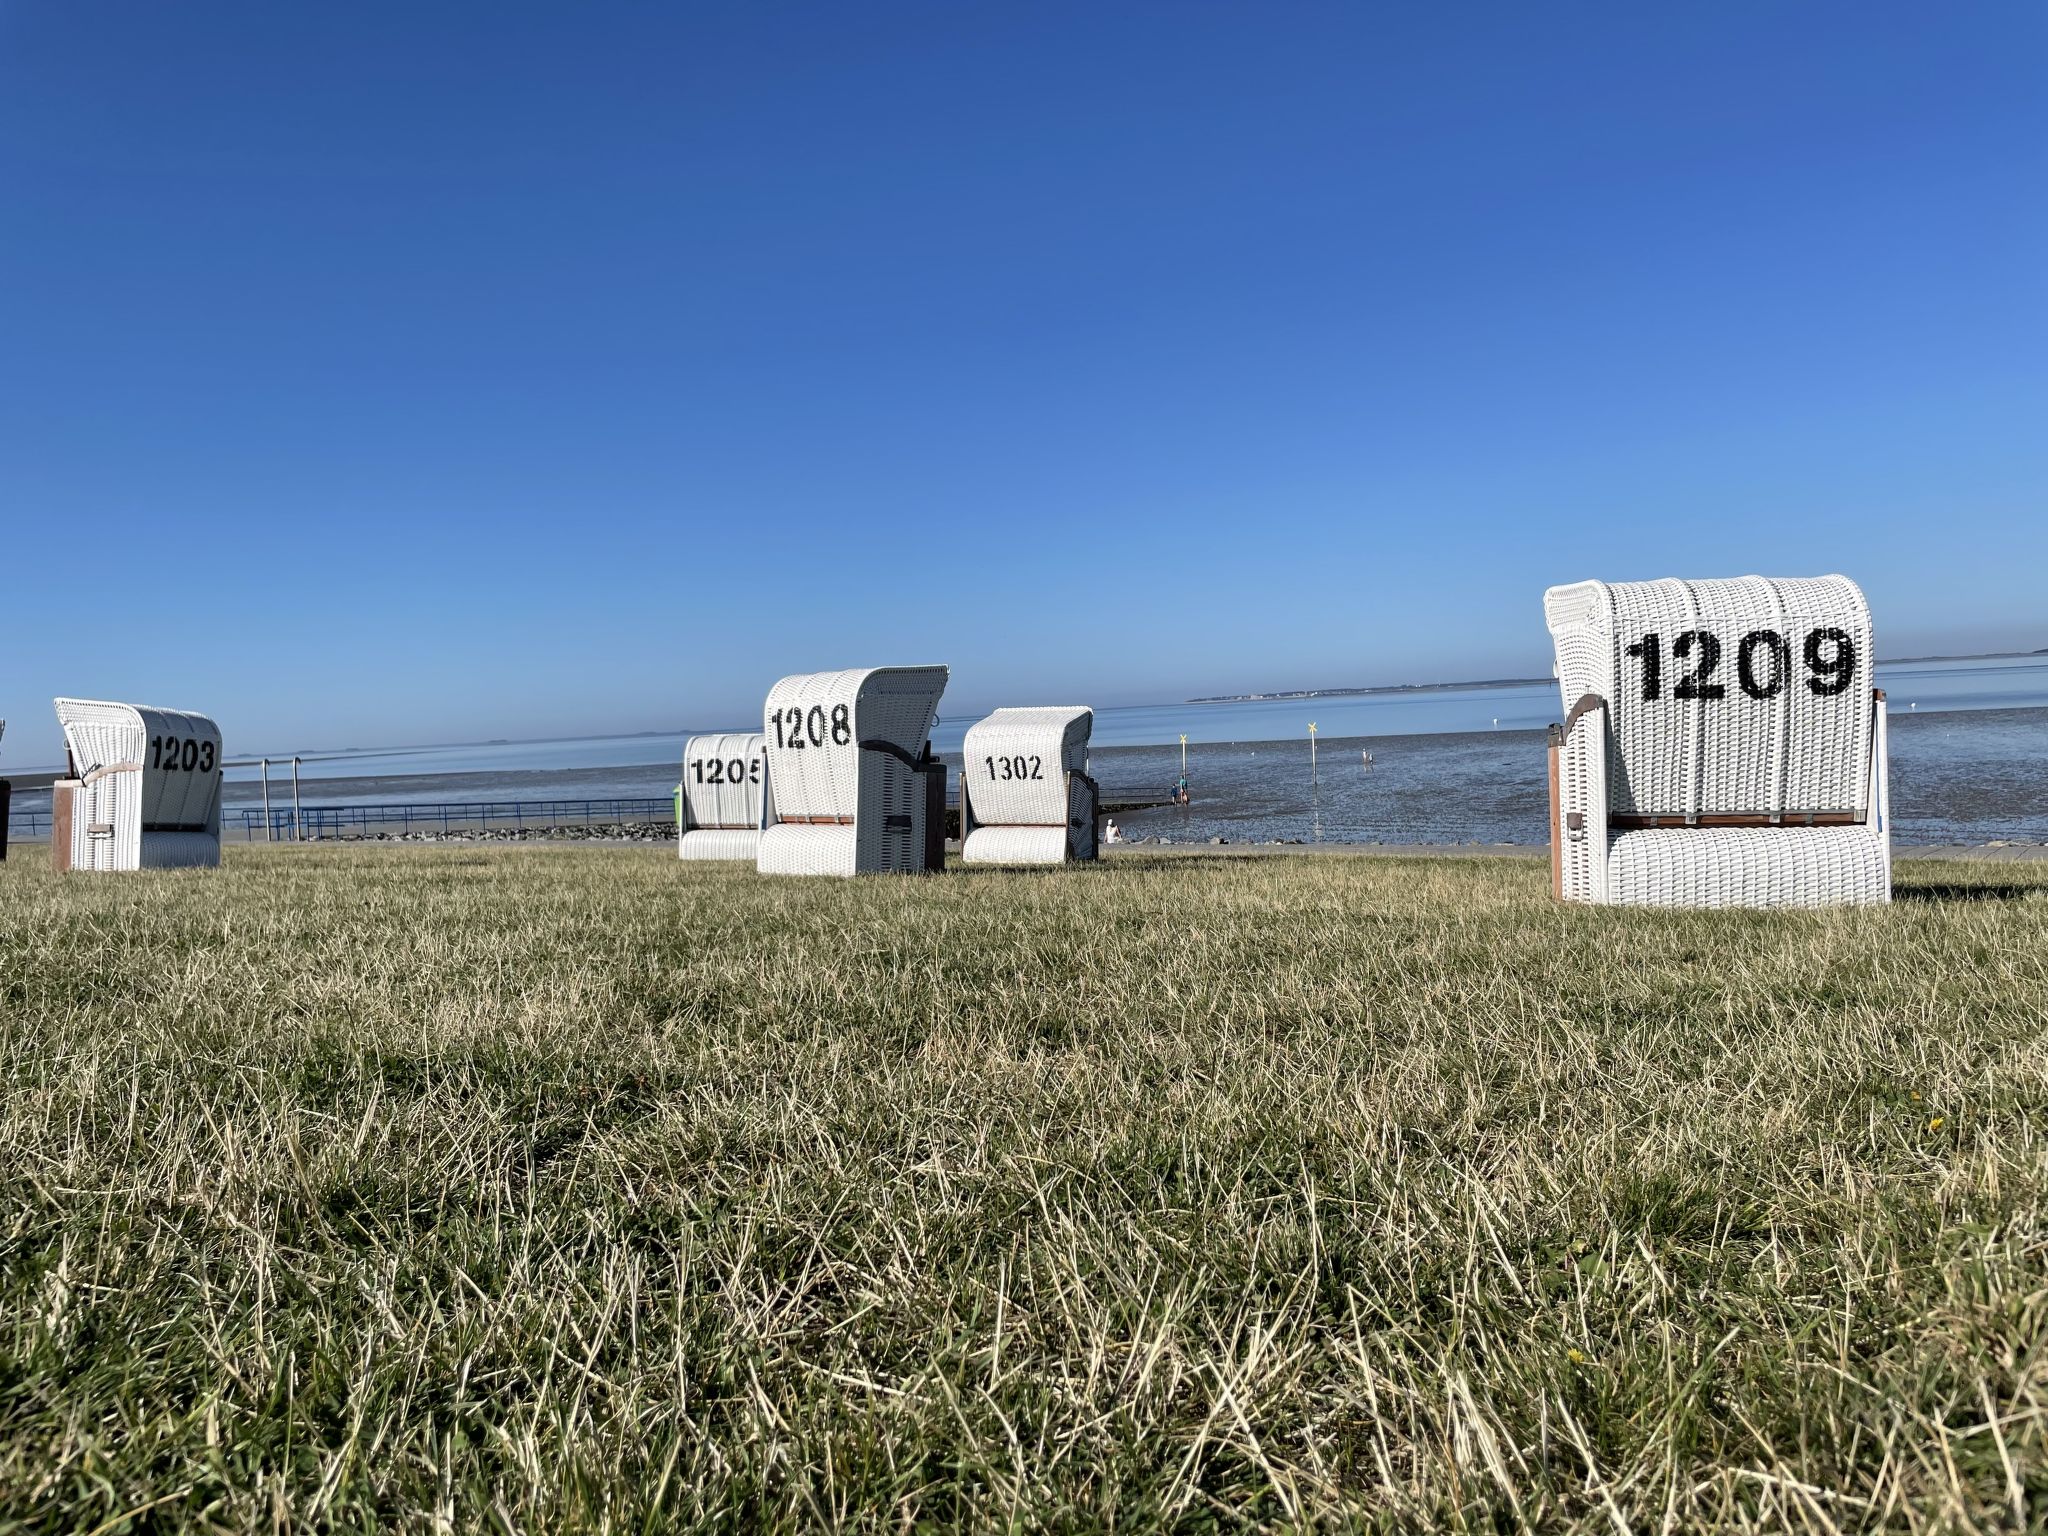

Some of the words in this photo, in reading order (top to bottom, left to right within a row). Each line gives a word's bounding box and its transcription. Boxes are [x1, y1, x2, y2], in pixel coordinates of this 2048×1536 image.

[1624, 627, 1856, 701] 1209
[772, 703, 850, 749] 1208
[152, 735, 214, 772] 1203
[986, 755, 1043, 781] 1302
